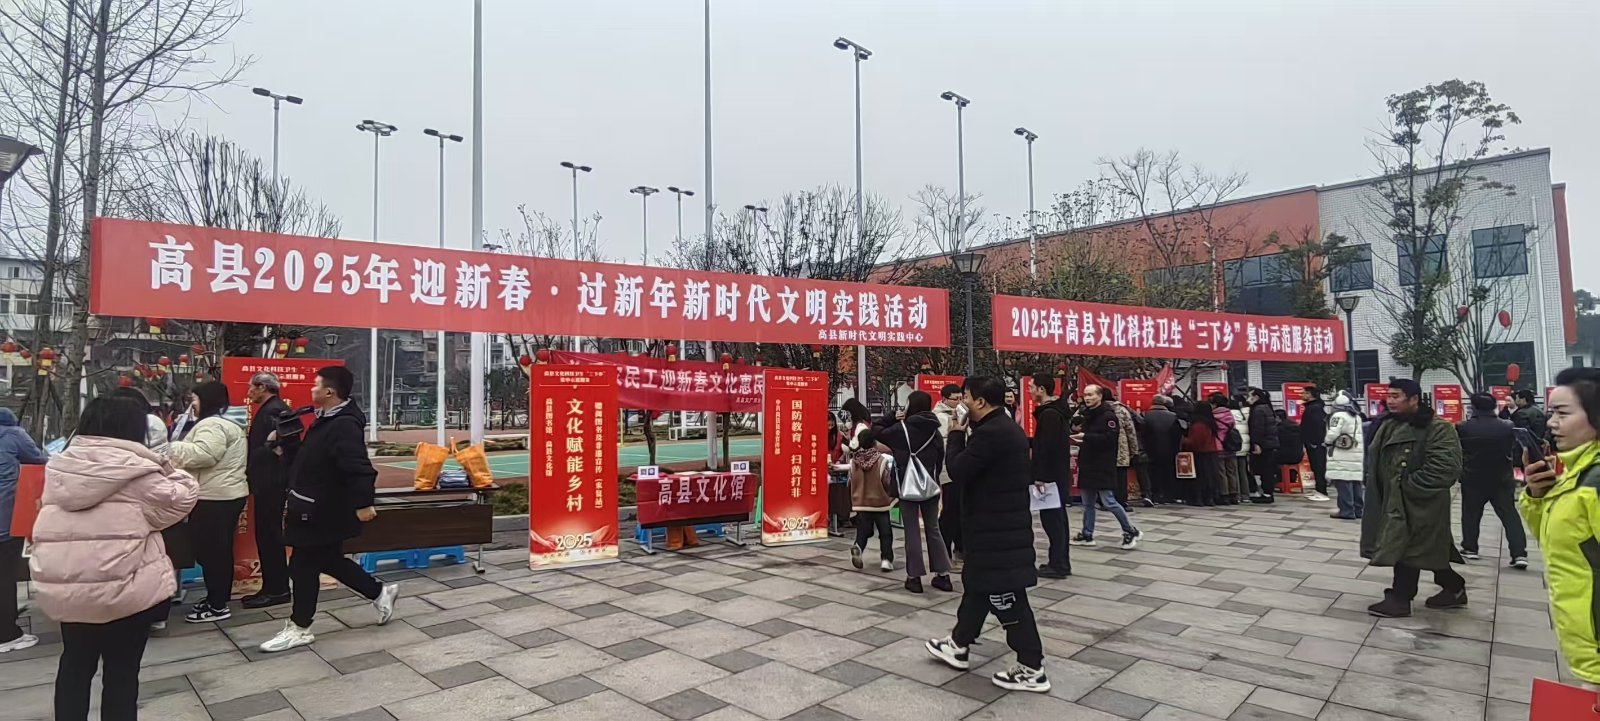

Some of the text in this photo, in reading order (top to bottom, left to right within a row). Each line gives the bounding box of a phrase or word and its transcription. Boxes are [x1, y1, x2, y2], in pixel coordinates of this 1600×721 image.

[149, 235, 927, 329] 高县2025年迎新春·过新年新时代文明实践活动
[818, 329, 923, 342] 高县新时代文明实践中心
[1011, 306, 1333, 354] 2025年高县文化科技卫生“三下乡”集中示范服务活动
[566, 398, 584, 512] 文化赋能乡村
[791, 399, 802, 498] 国防教育、扫黄打非
[658, 475, 745, 506] 高县文化馆
[554, 533, 592, 551] 2025
